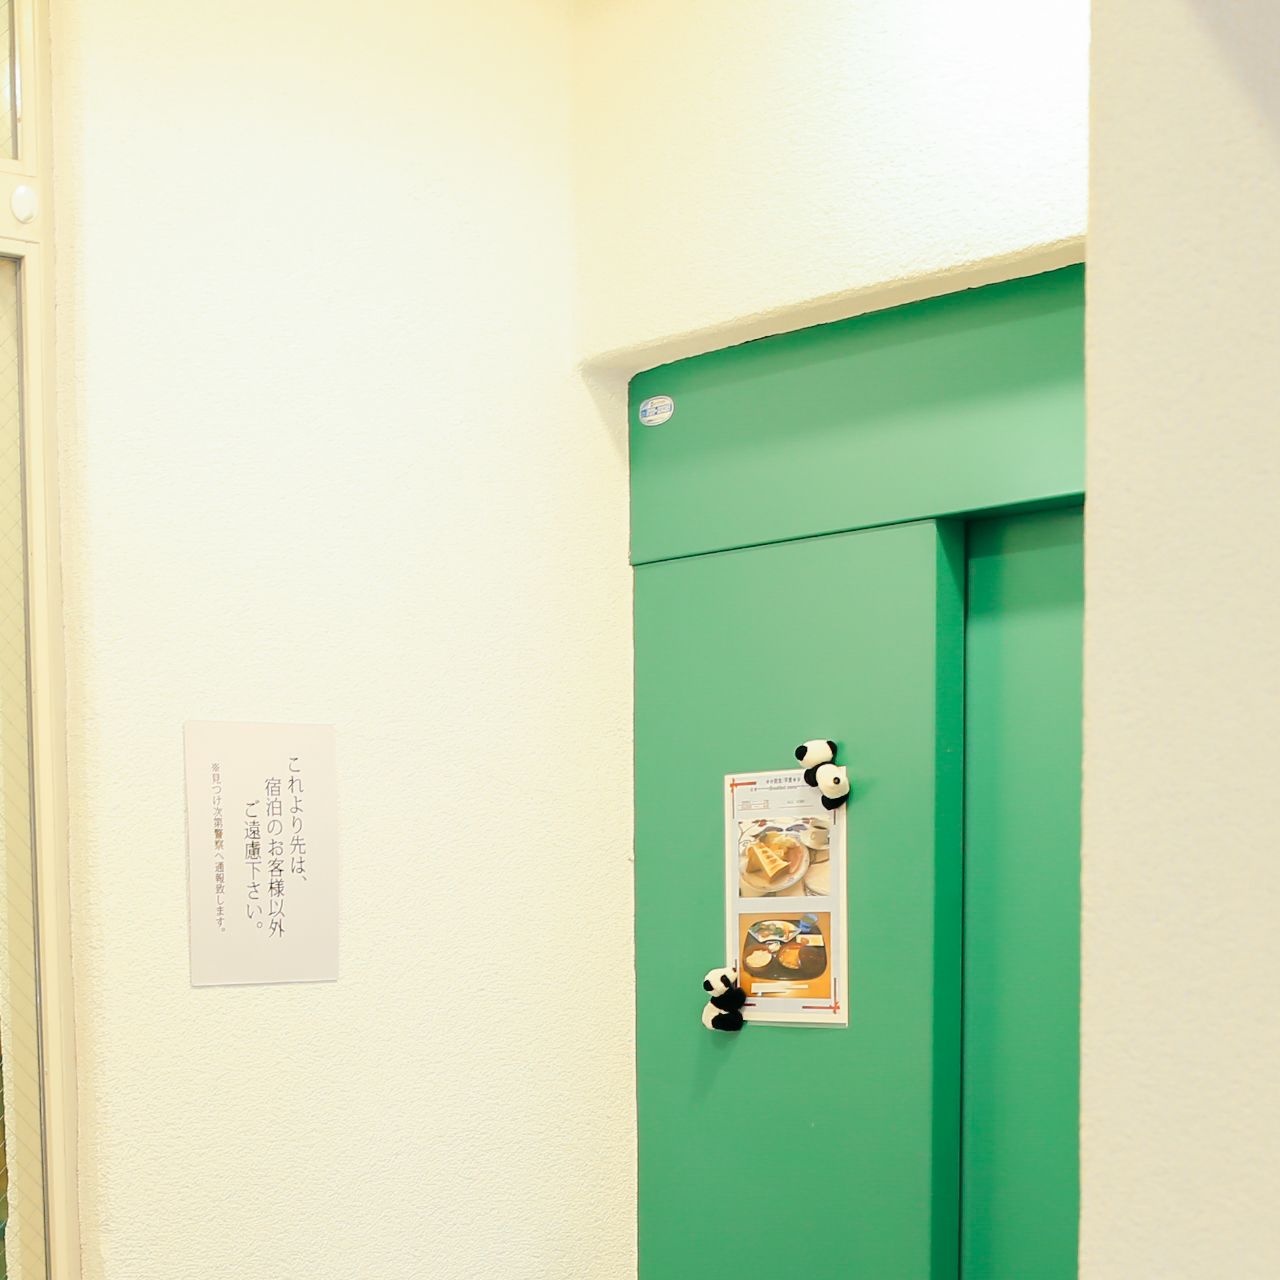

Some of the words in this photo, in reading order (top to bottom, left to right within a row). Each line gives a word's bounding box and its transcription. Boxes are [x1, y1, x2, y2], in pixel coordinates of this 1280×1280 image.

[244, 799, 264, 930] ご遠慮下さい。
[264, 776, 286, 938] 宿泊のお客様以外
[287, 756, 308, 882] これより先は、
